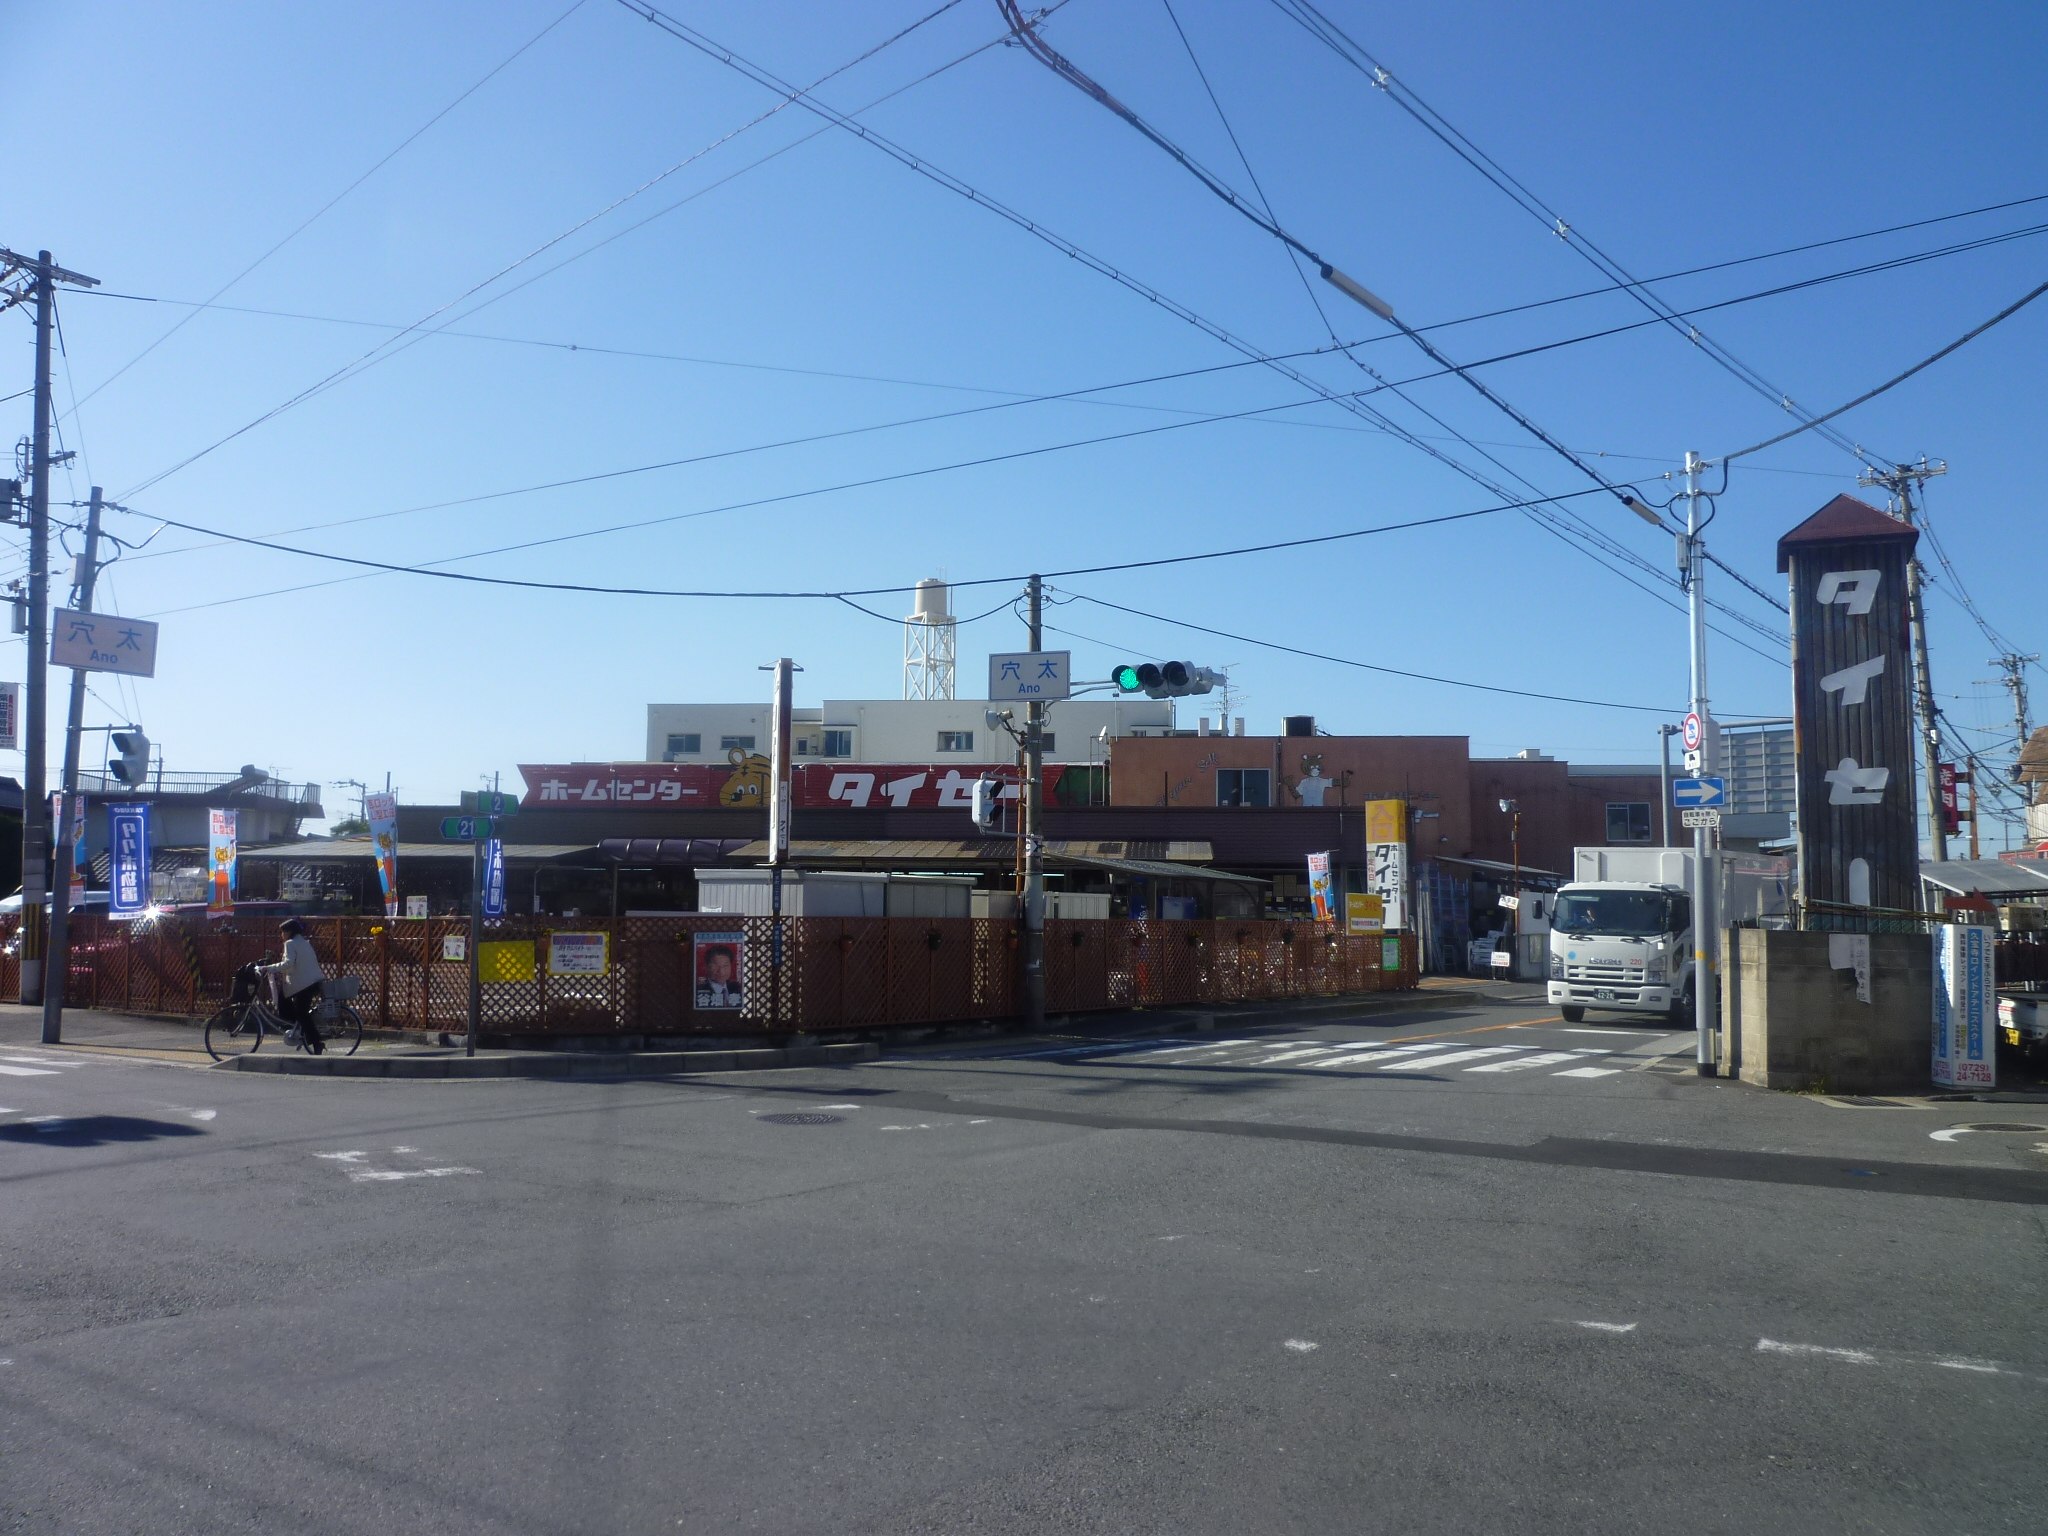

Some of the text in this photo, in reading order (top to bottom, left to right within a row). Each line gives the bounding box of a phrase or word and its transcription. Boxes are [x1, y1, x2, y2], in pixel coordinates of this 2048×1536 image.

[67, 621, 142, 651] 穴太
[90, 650, 118, 664] Ano
[1001, 660, 1058, 681] 穴太
[1018, 682, 1041, 694] Ano
[1816, 569, 1891, 906] タイセー
[540, 779, 698, 801] ホームセンター
[828, 769, 1030, 808] タイセー
[460, 821, 475, 836] 21
[1684, 818, 1717, 826] ここから
[1391, 845, 1400, 904] ホームセンター
[1630, 958, 1642, 966] 220
